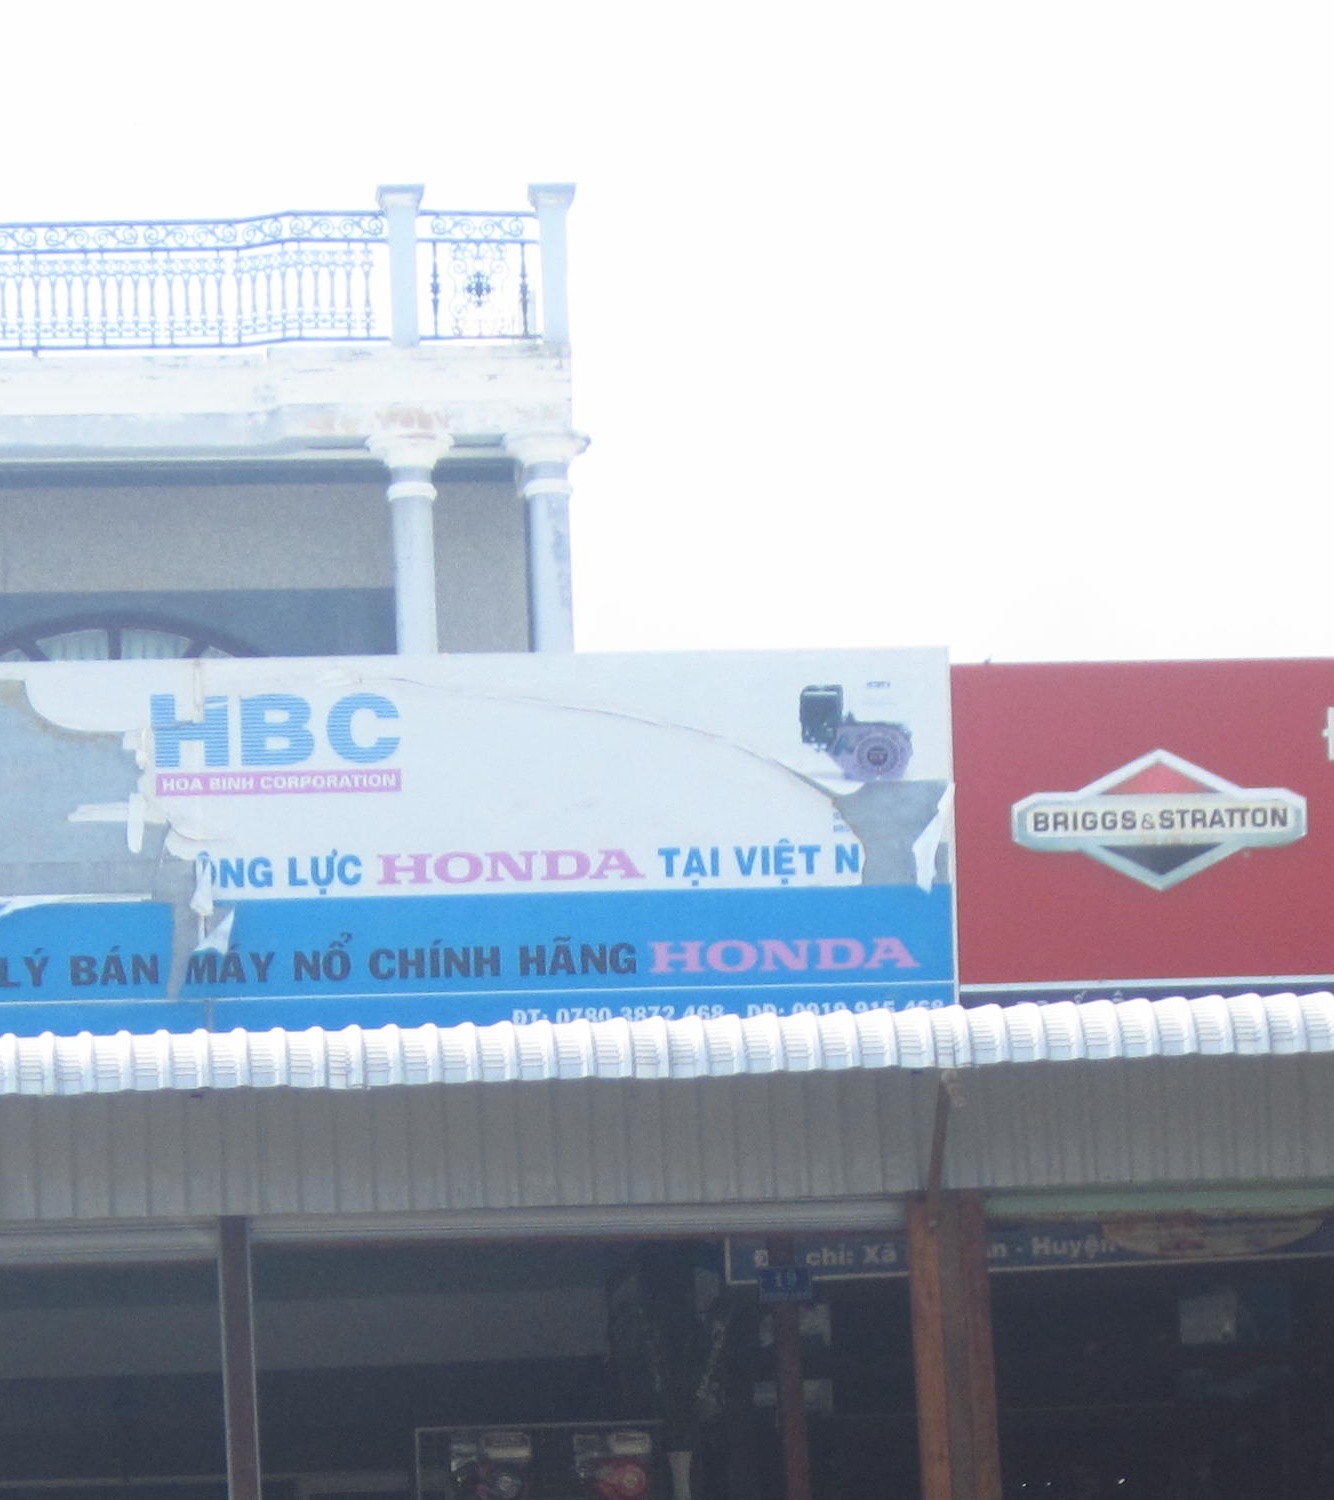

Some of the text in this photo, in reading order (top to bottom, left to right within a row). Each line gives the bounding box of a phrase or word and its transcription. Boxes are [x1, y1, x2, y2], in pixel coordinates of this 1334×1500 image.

[150, 692, 400, 768] HBC
[163, 777, 203, 792] HOA
[260, 773, 397, 790] CORPORATION
[288, 849, 363, 895] LỰC
[377, 848, 644, 886] HONDA
[657, 846, 720, 886] TẠI
[731, 839, 825, 884] VIỆT
[71, 945, 159, 986] BÁN
[186, 941, 277, 984] MÁY
[294, 932, 354, 982] NỔ
[368, 934, 501, 980] CHÍNH
[518, 931, 637, 976] HÃNG
[649, 936, 919, 973] HONDA
